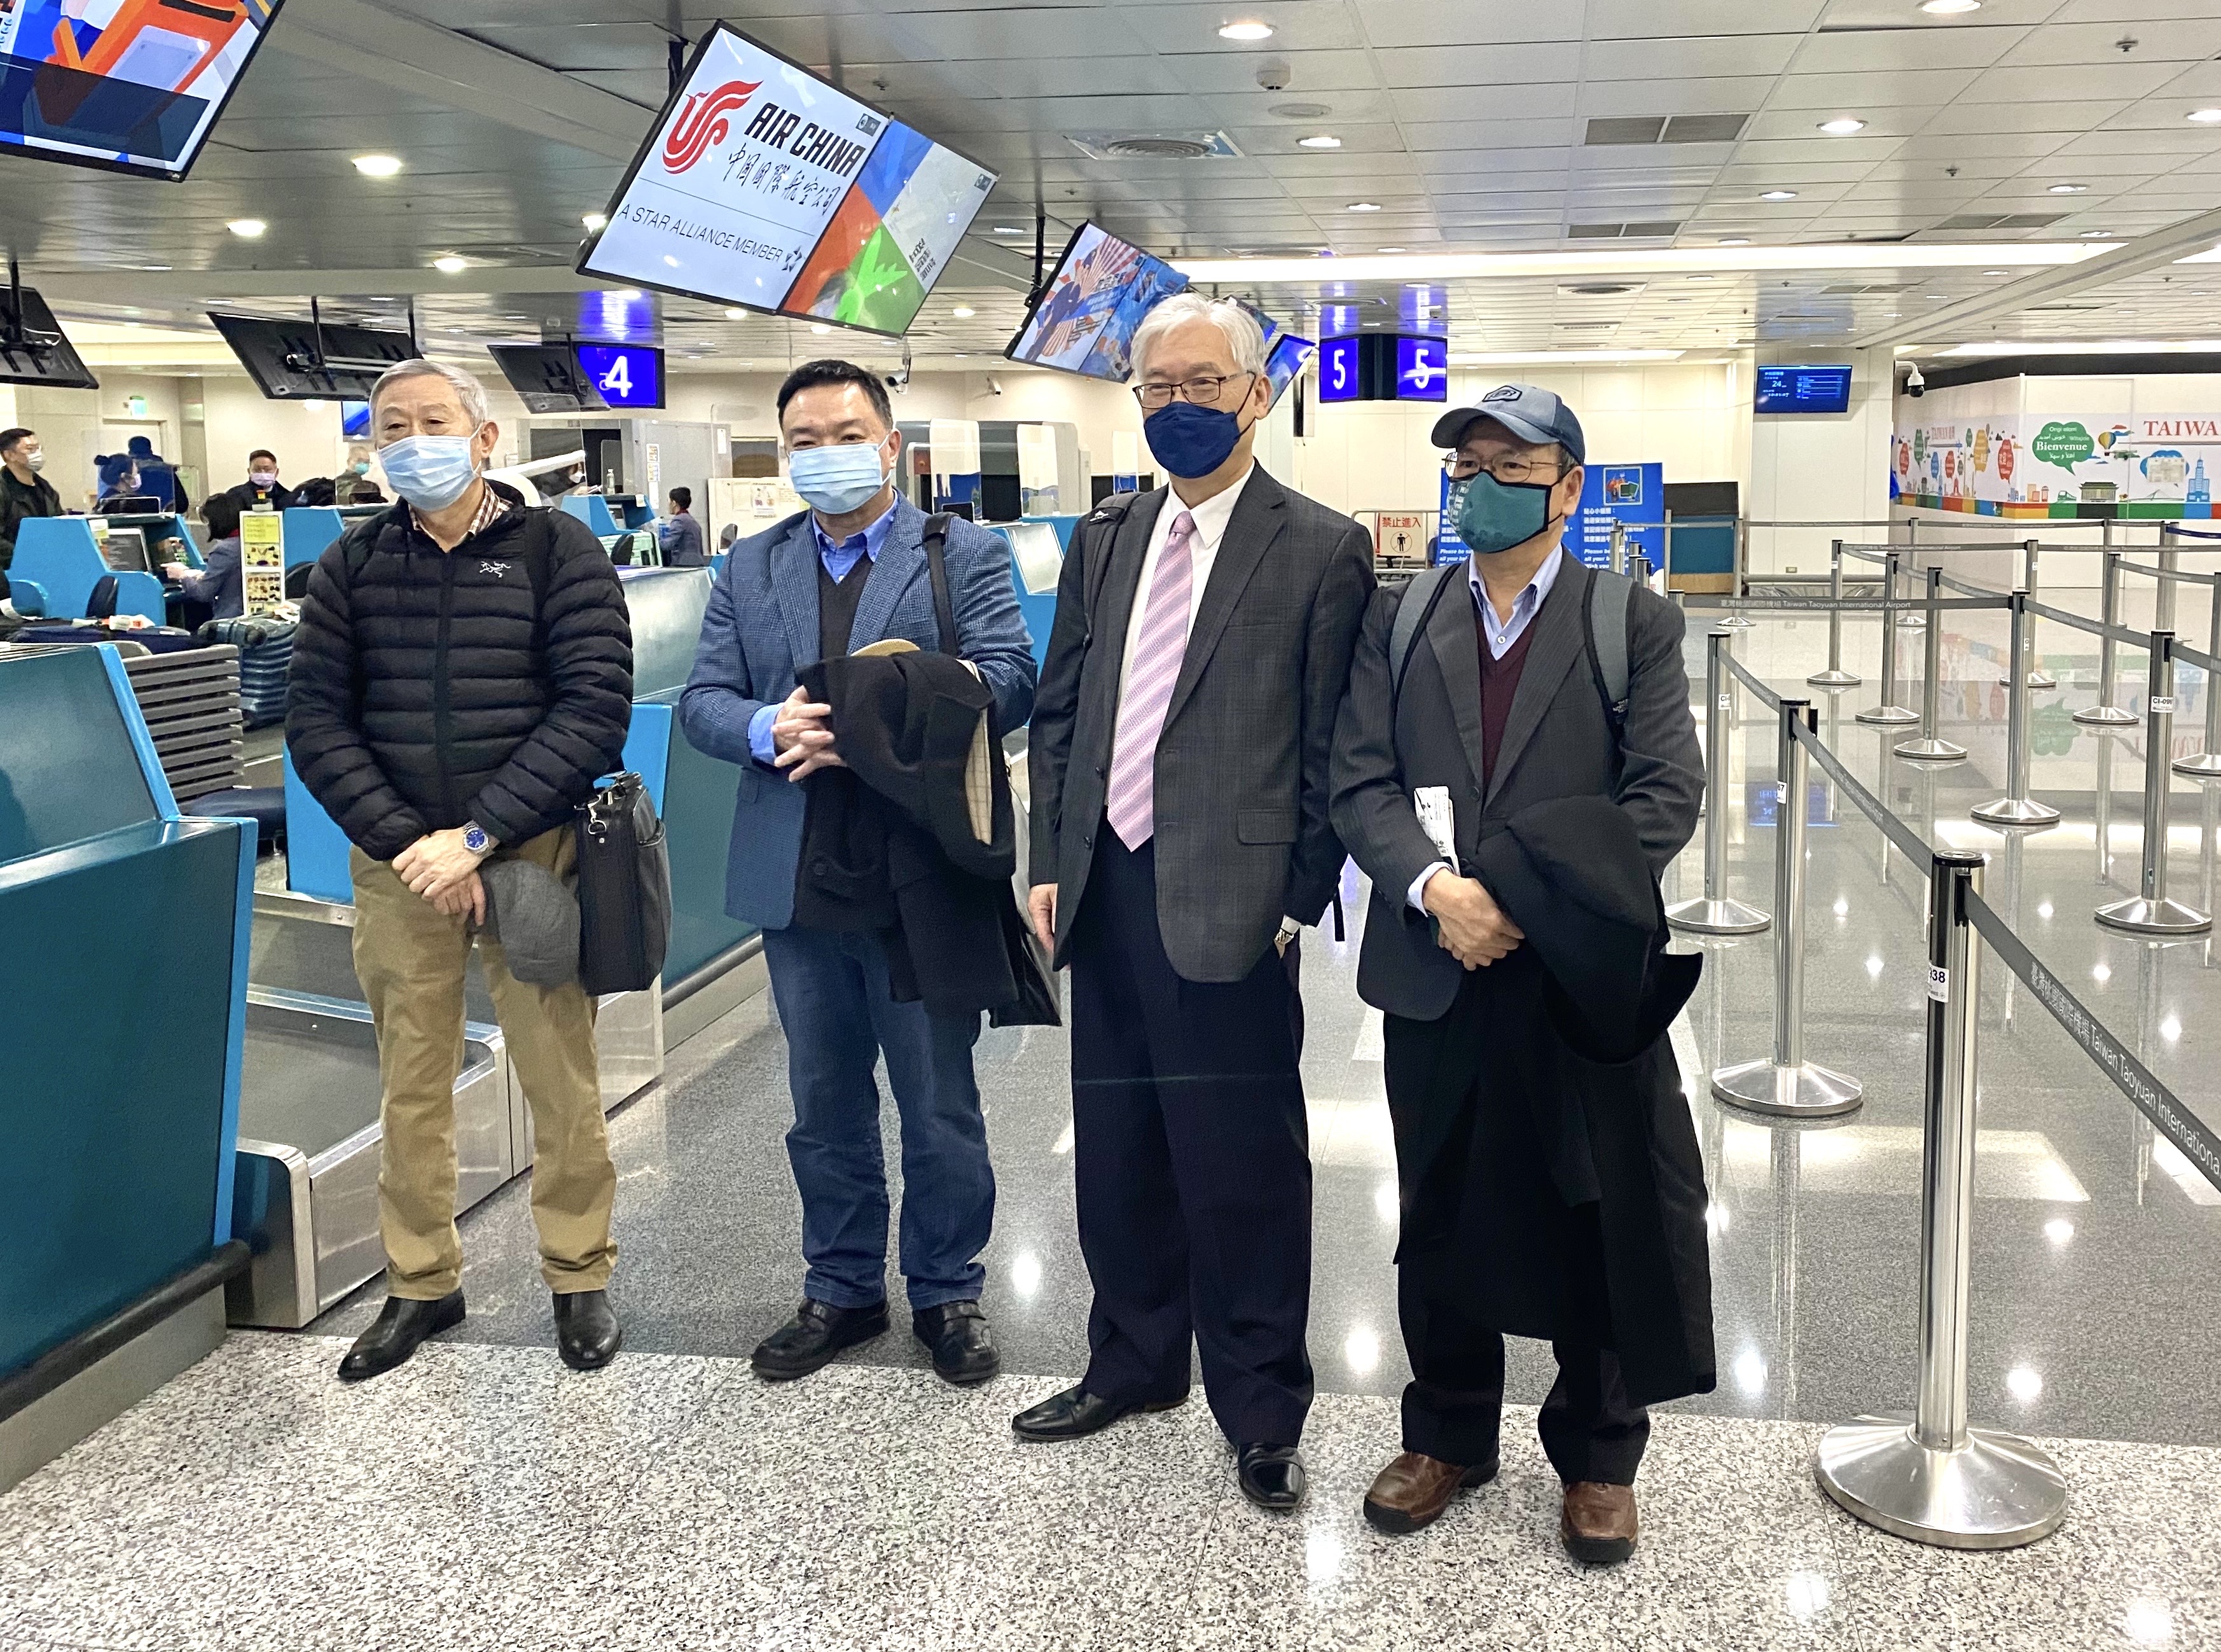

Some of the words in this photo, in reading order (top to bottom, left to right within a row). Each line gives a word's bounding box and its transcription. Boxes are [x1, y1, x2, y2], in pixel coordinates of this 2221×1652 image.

[744, 102, 801, 149] AIR
[789, 122, 866, 177] CHINA
[618, 203, 630, 219] A
[632, 207, 670, 230] STAR
[670, 219, 735, 249] ALLIANCE
[731, 237, 784, 262] MEMBER
[605, 356, 633, 398] 4
[1333, 349, 1346, 390] 5
[1415, 349, 1430, 389] 5
[2037, 441, 2087, 451] Bienvenue
[2143, 420, 2221, 436] TAIWA
[1382, 517, 1422, 528] 禁止進入
[1809, 600, 1837, 609] Taoyuan
[2091, 1024, 2118, 1071] Taiwan
[2120, 1053, 2156, 1111] Taoyuan
